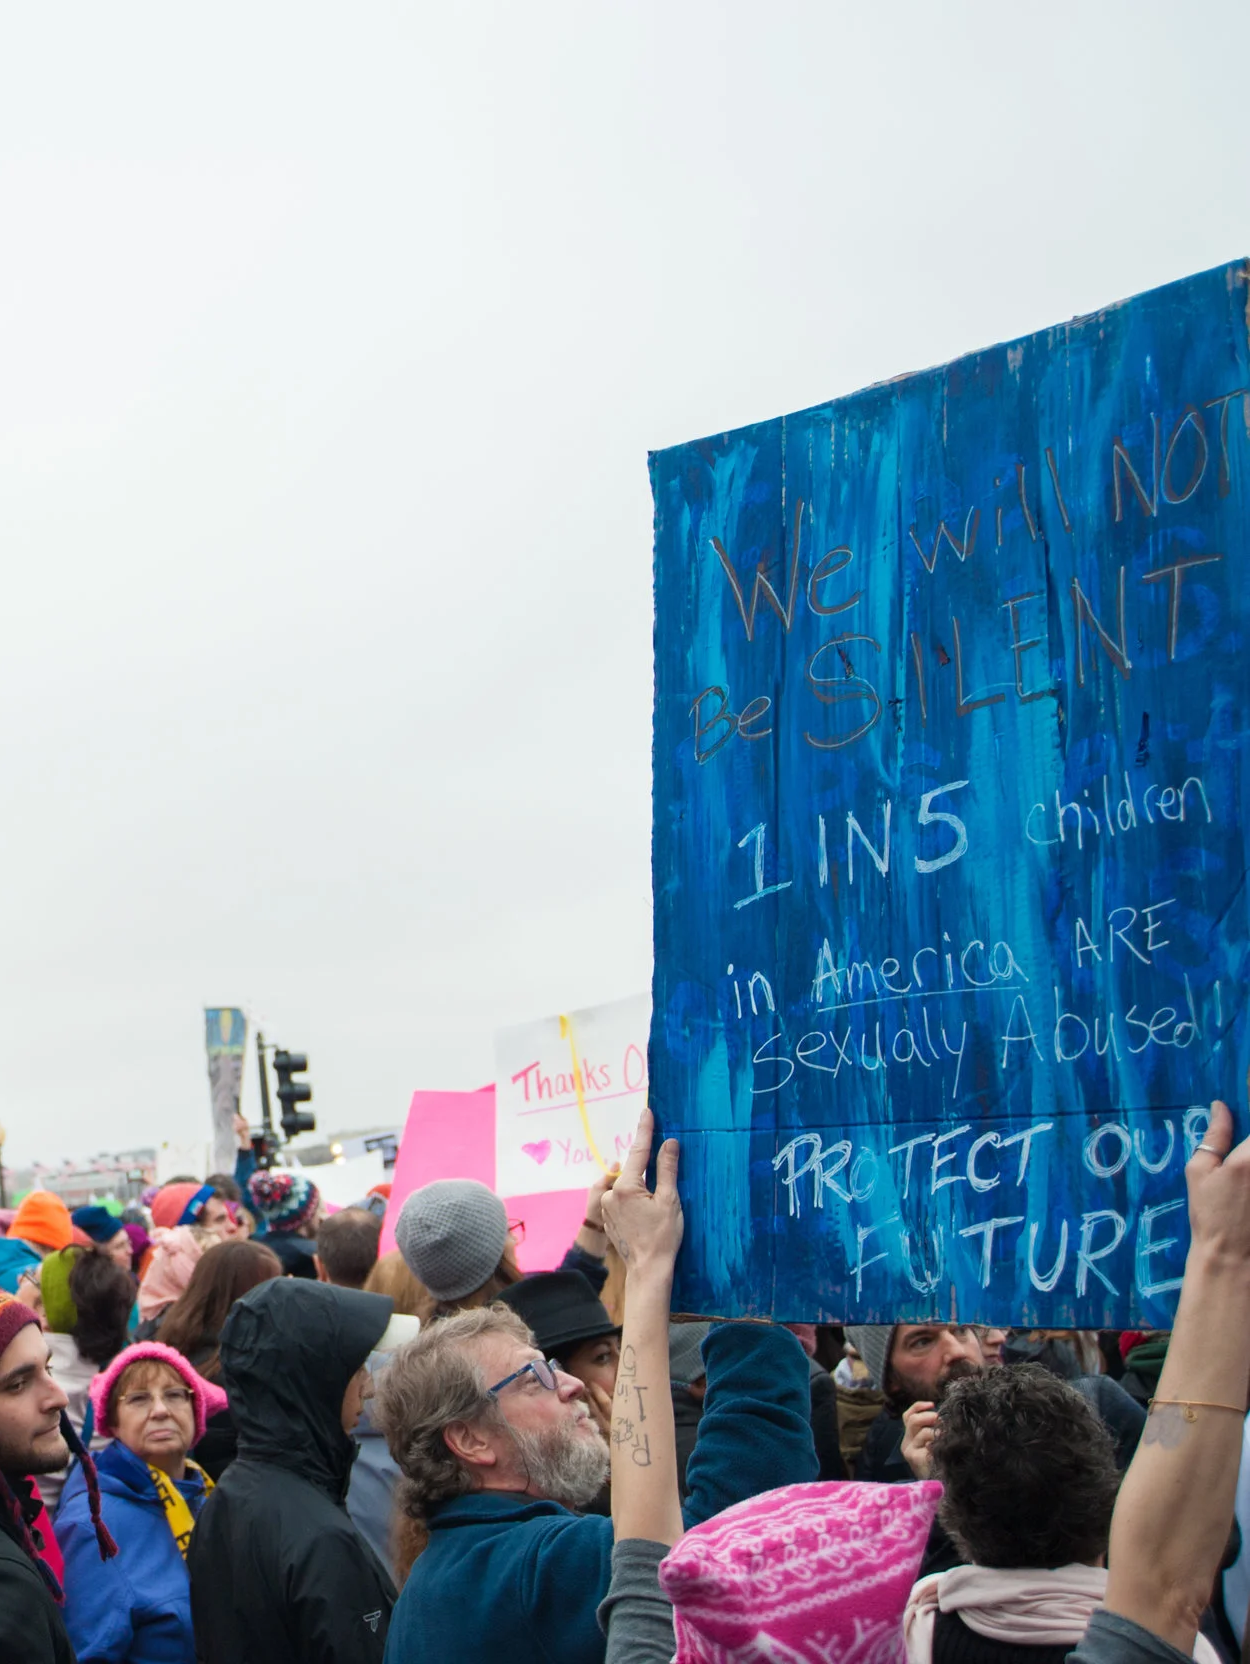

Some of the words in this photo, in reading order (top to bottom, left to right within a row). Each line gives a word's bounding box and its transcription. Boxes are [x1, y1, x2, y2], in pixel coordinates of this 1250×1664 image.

[709, 497, 864, 643] We
[1112, 387, 1249, 523] NOT
[690, 682, 774, 766] Be
[805, 555, 1222, 751] SILENT
[733, 821, 793, 910] 1
[1025, 771, 1213, 850] children
[726, 963, 776, 1019] in
[810, 931, 1030, 1004] America
[1075, 897, 1177, 968] ARE
[511, 1058, 611, 1102] Thanks
[772, 1123, 1054, 1219] PROTECT
[850, 1199, 1187, 1303] FUTURE
